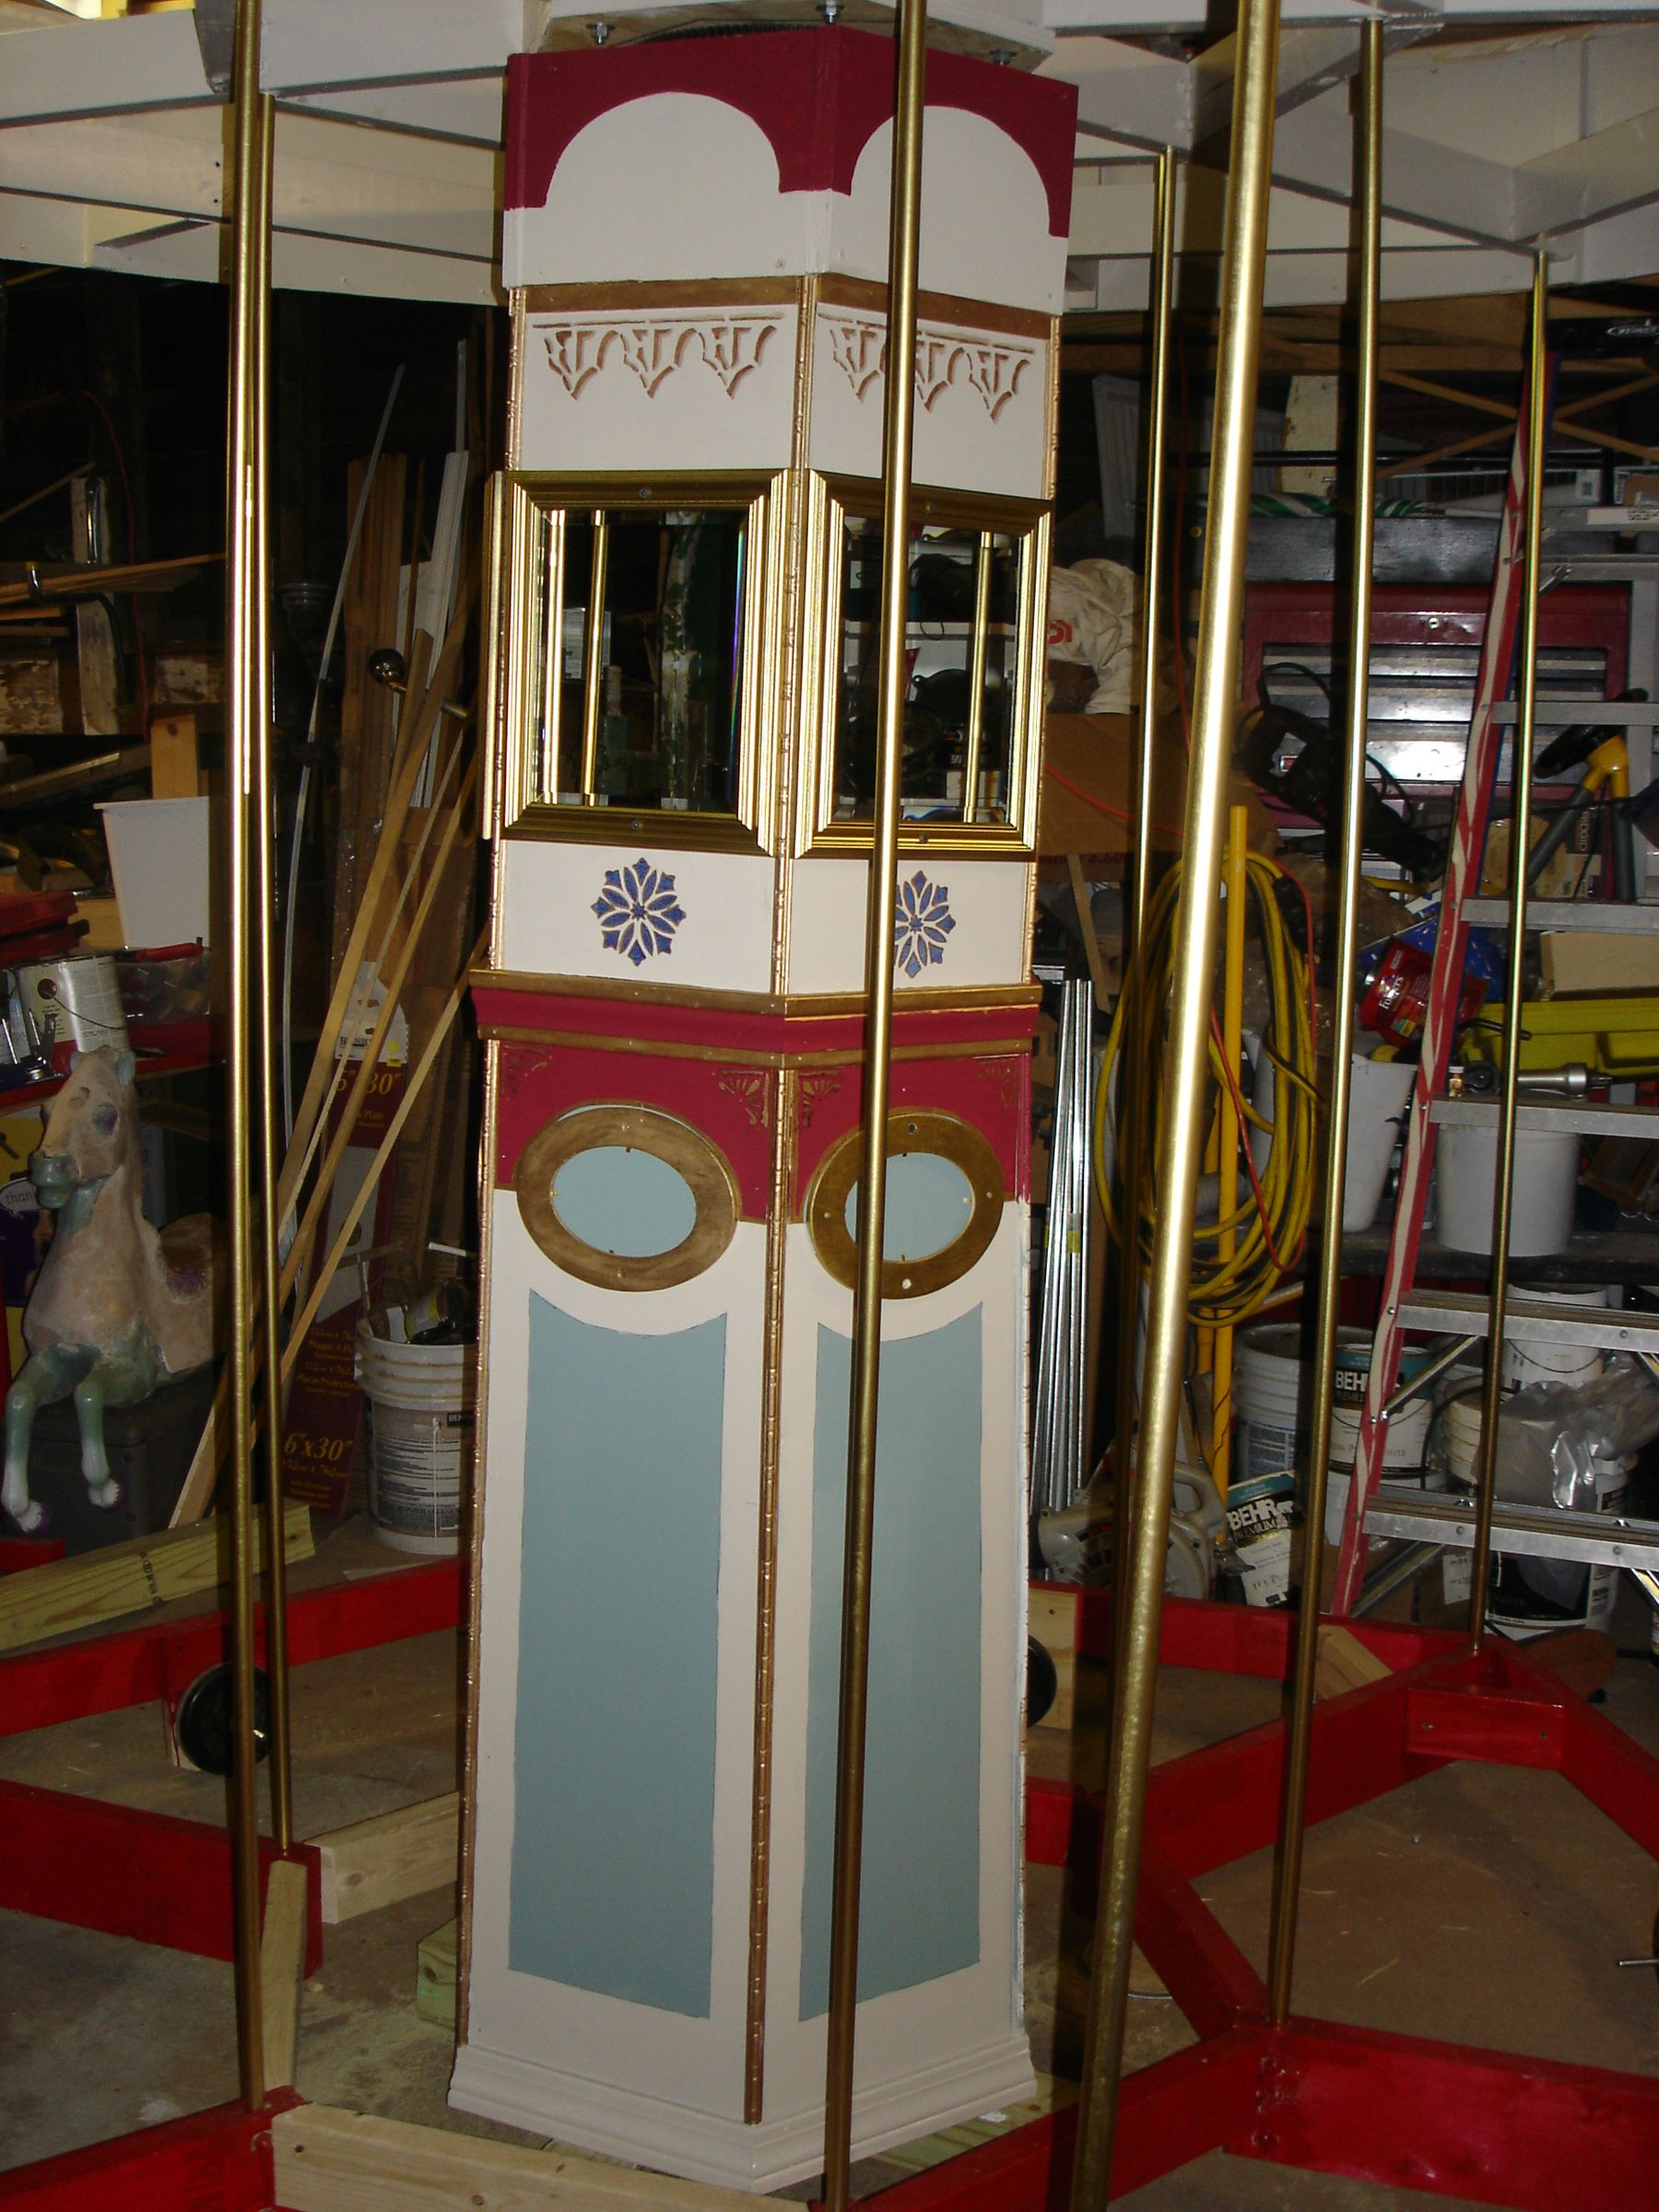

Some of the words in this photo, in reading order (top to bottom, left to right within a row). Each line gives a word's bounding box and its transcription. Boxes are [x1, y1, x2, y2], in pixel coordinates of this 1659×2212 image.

[6, 1190, 33, 1206] than
[1335, 1371, 1369, 1393] BEH
[1226, 1498, 1277, 1532] BEHR
